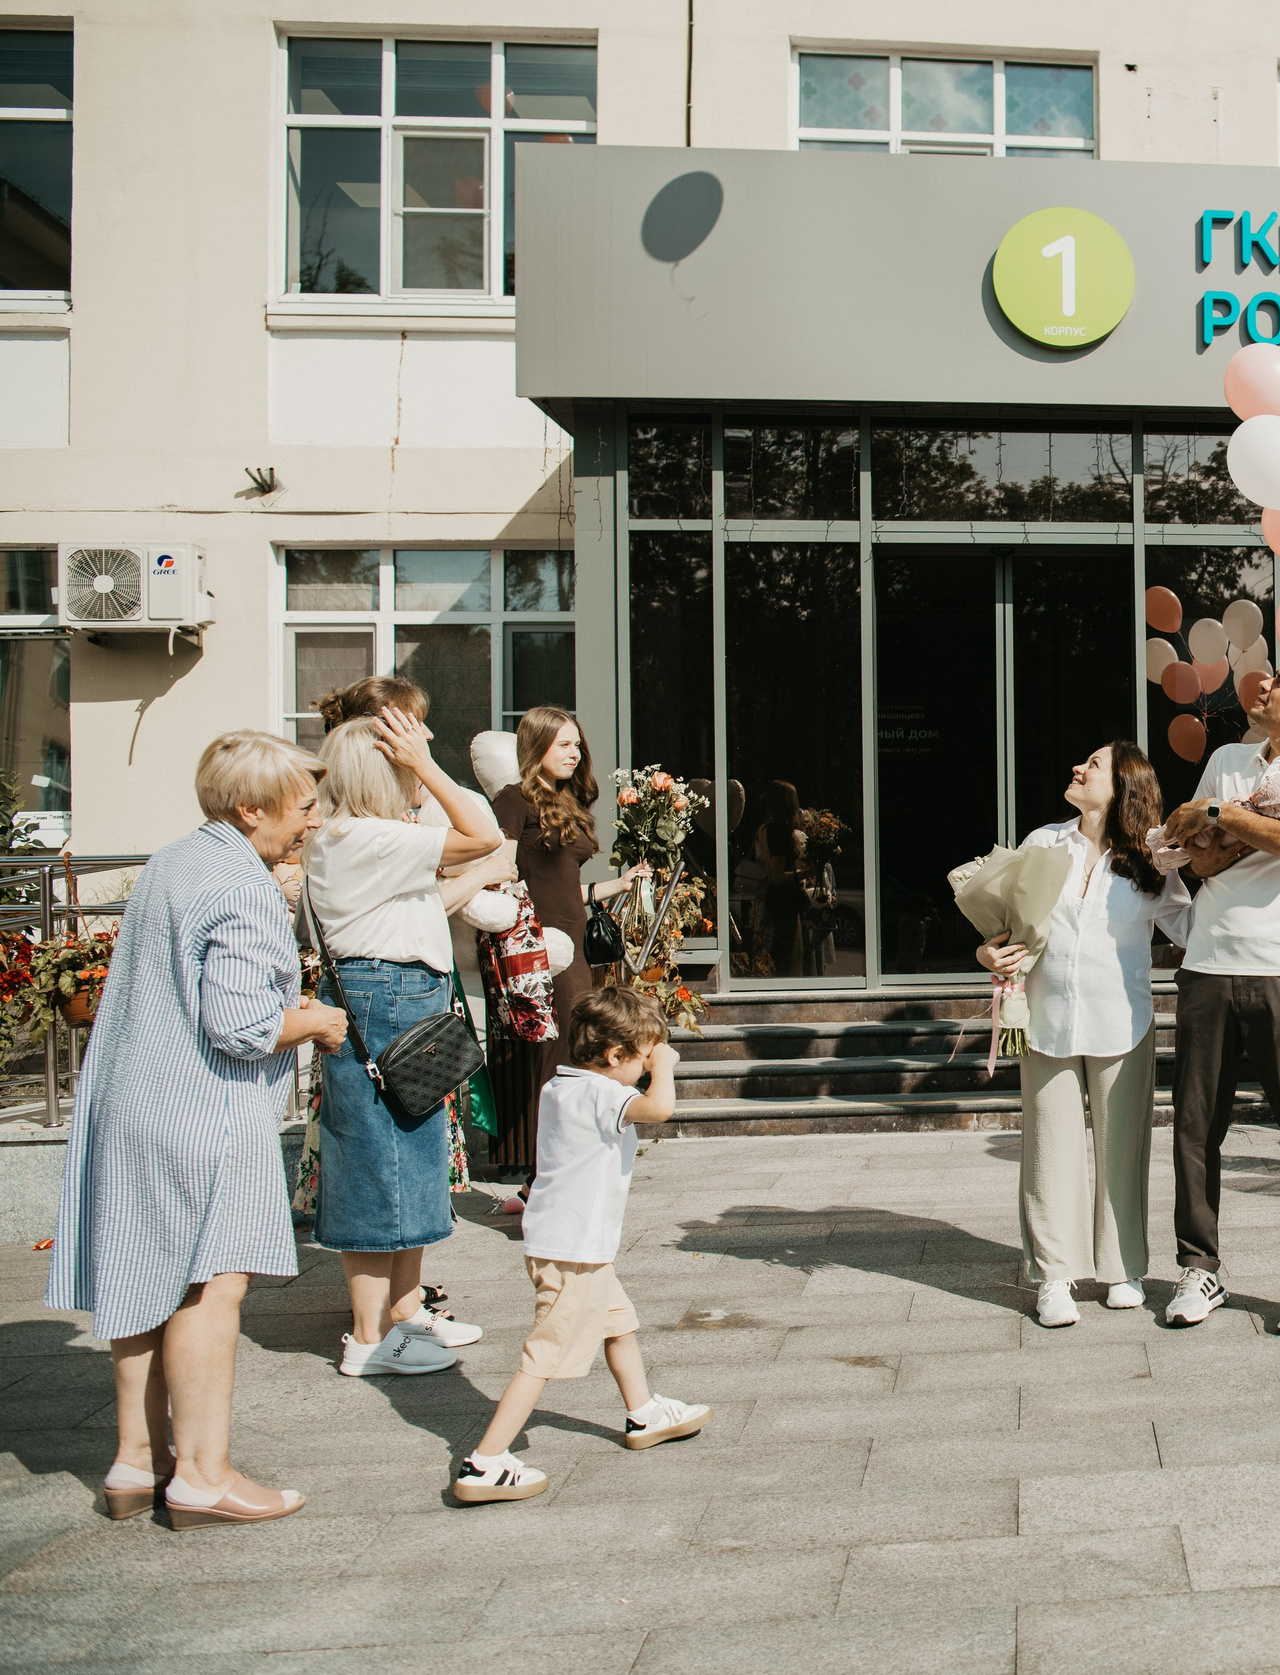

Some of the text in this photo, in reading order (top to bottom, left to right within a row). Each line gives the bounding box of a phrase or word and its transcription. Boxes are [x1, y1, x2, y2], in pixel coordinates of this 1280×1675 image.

[1041, 235, 1076, 317] 1
[1044, 325, 1087, 337] КОРПУС
[152, 568, 179, 576] GREE
